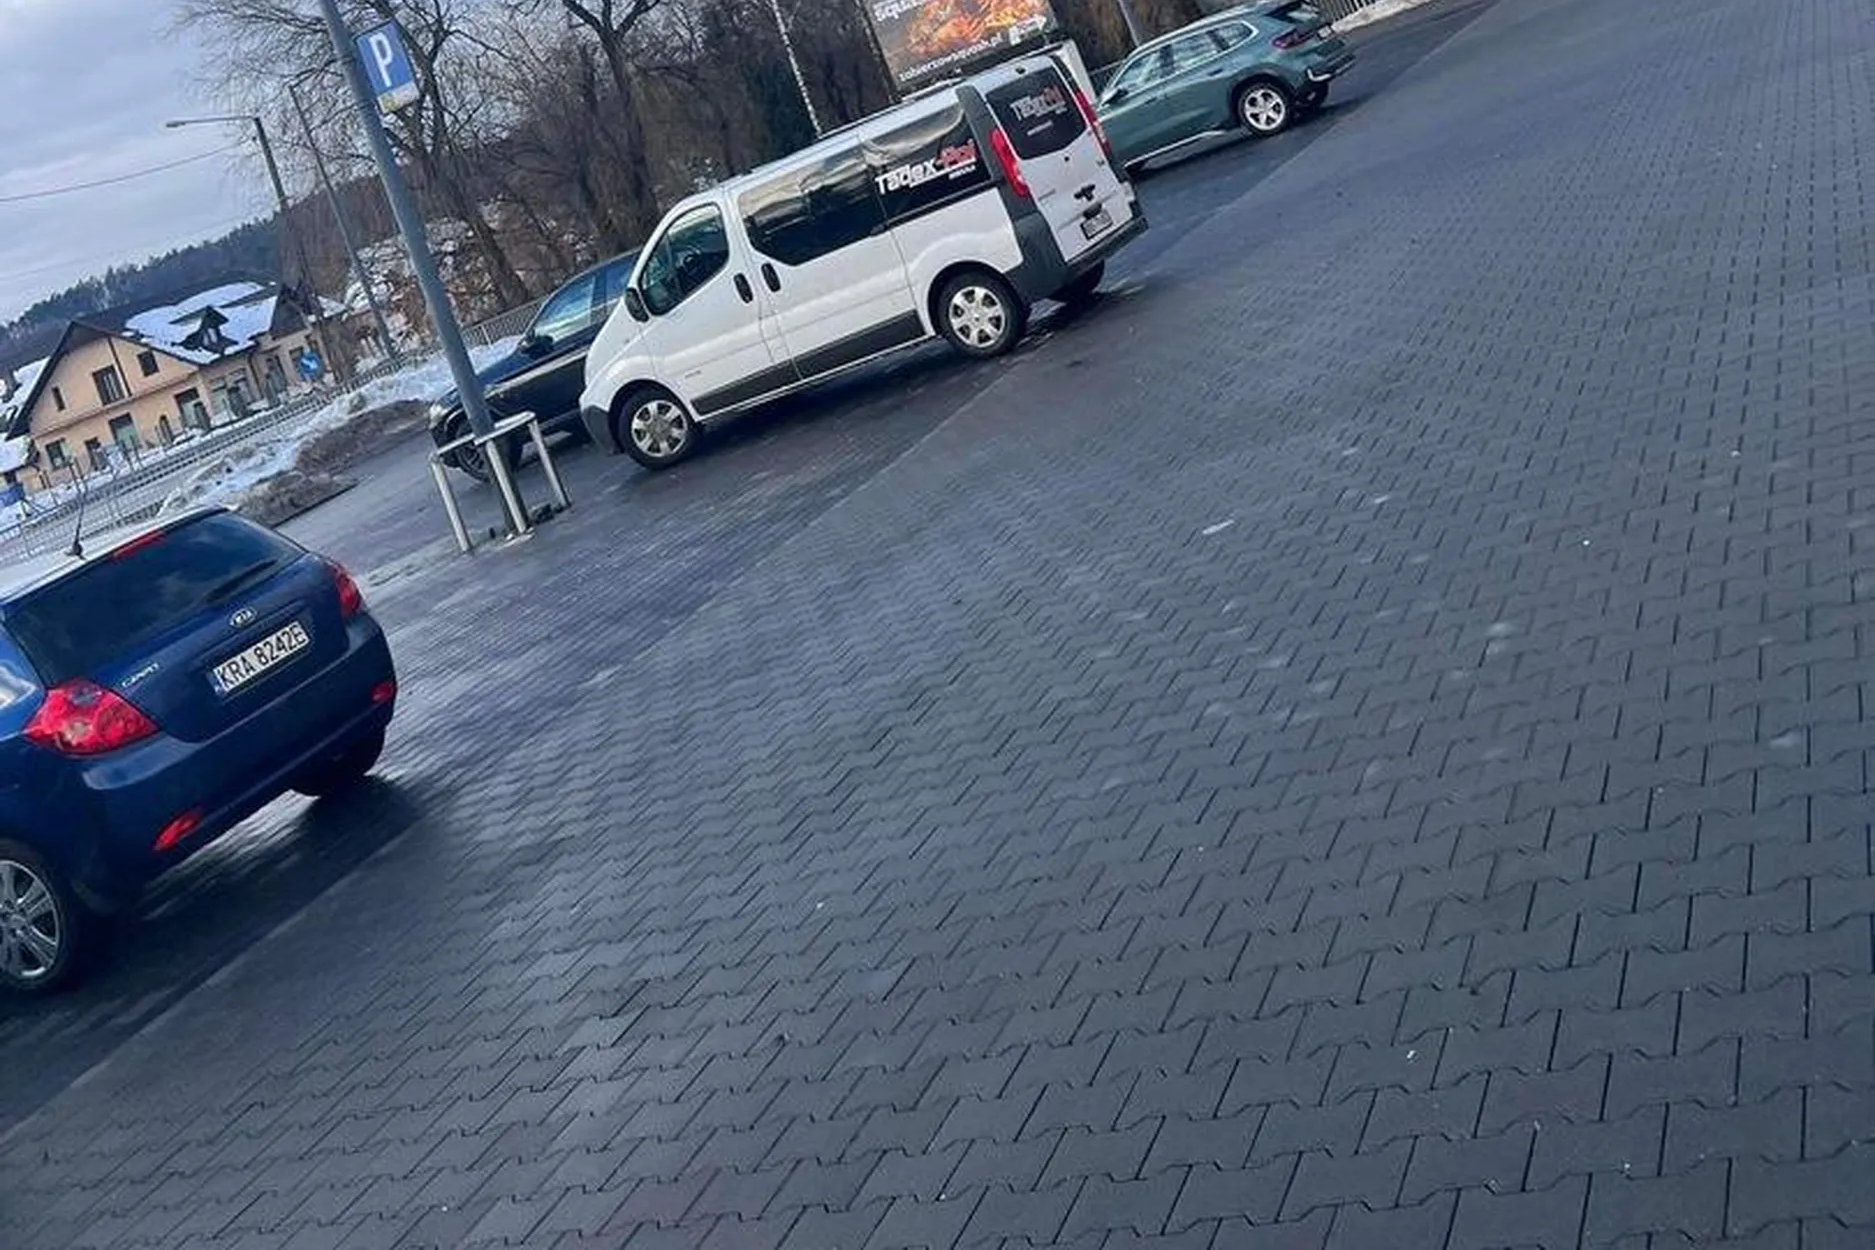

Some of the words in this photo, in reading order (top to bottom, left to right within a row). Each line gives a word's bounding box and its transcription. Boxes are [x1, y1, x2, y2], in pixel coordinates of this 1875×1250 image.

[368, 31, 393, 87] P
[217, 656, 257, 688] KRA
[254, 624, 307, 666] 8242E
